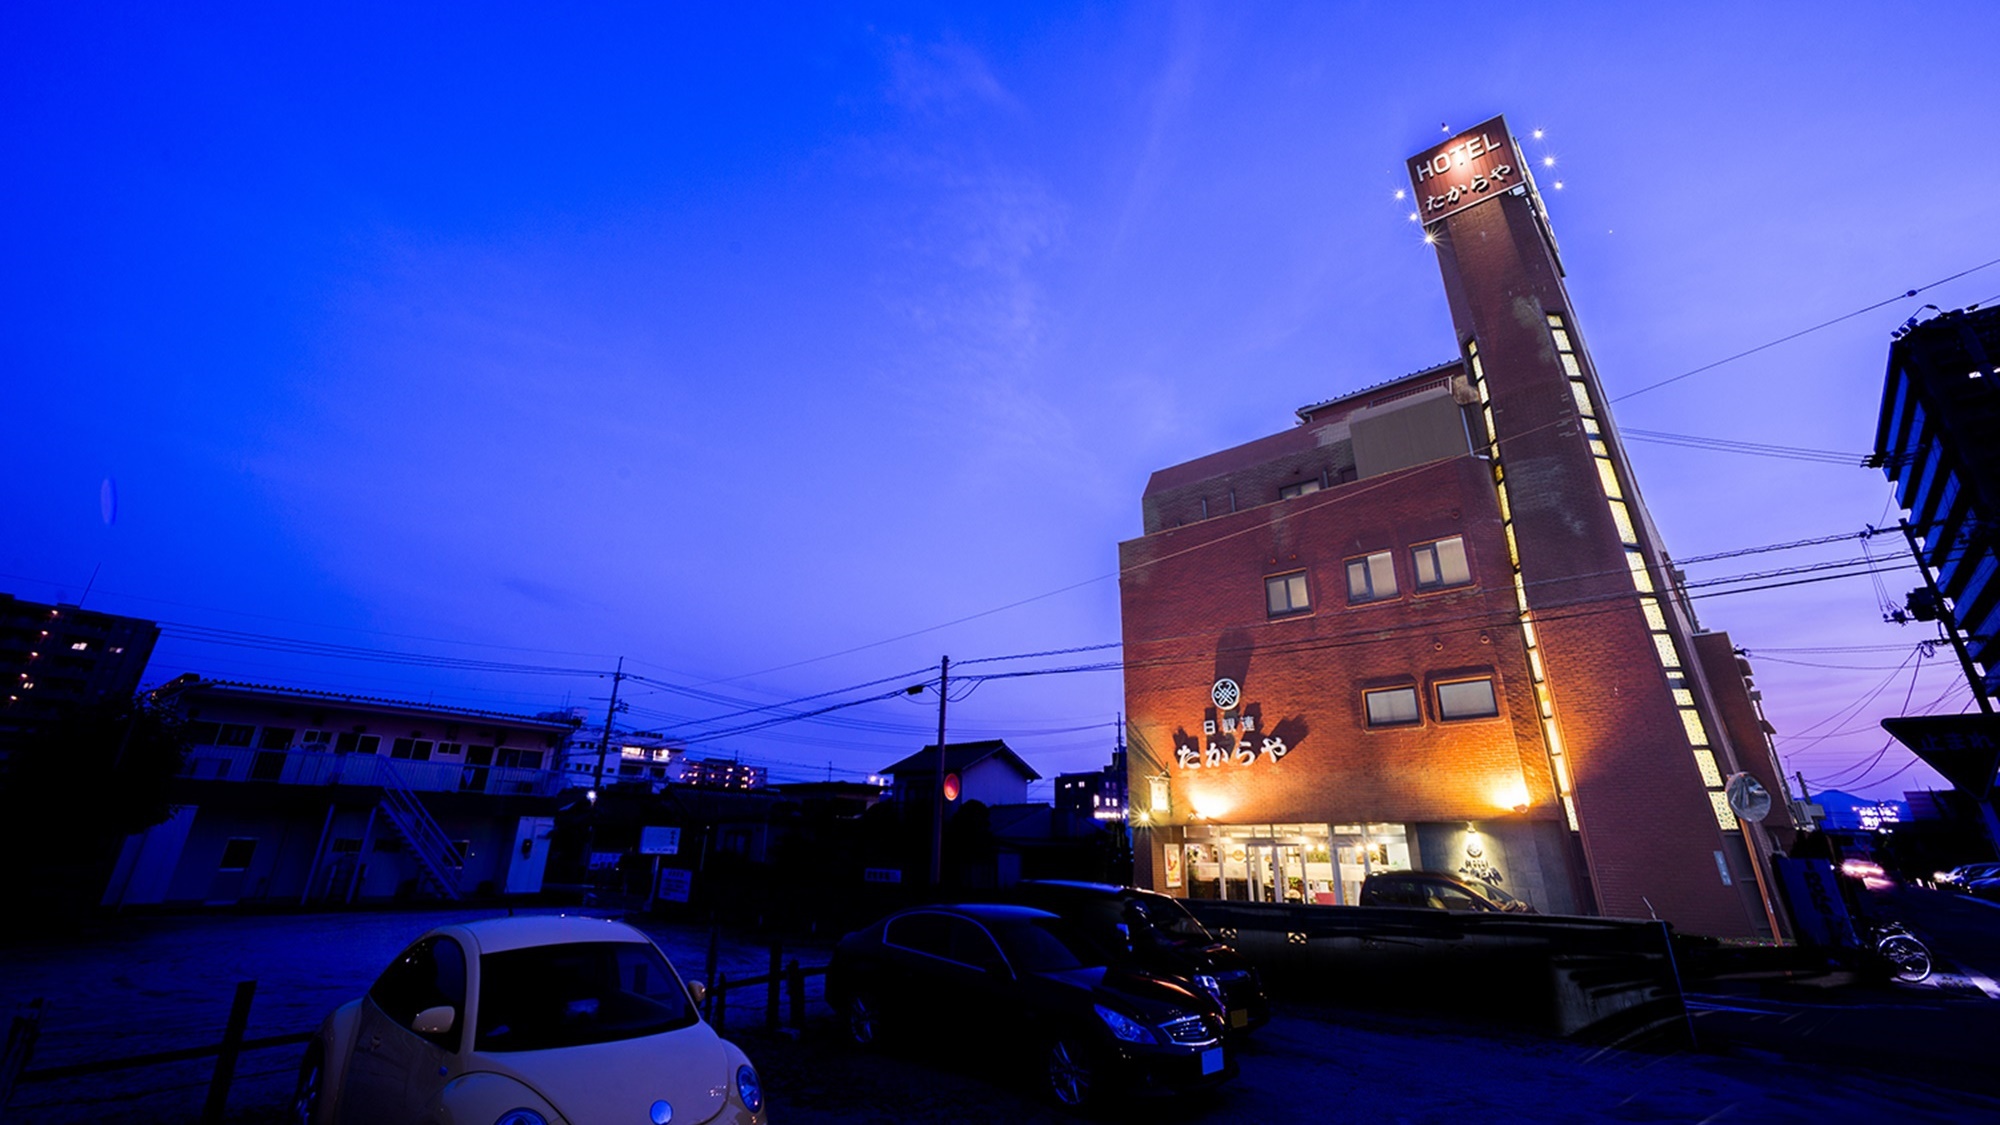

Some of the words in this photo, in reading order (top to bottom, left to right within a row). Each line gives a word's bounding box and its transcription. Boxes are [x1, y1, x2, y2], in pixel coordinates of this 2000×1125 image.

[1416, 133, 1501, 181] HOTEL
[1425, 164, 1511, 211] たからや
[1203, 716, 1255, 735] 日観連
[1177, 736, 1287, 769] たからや
